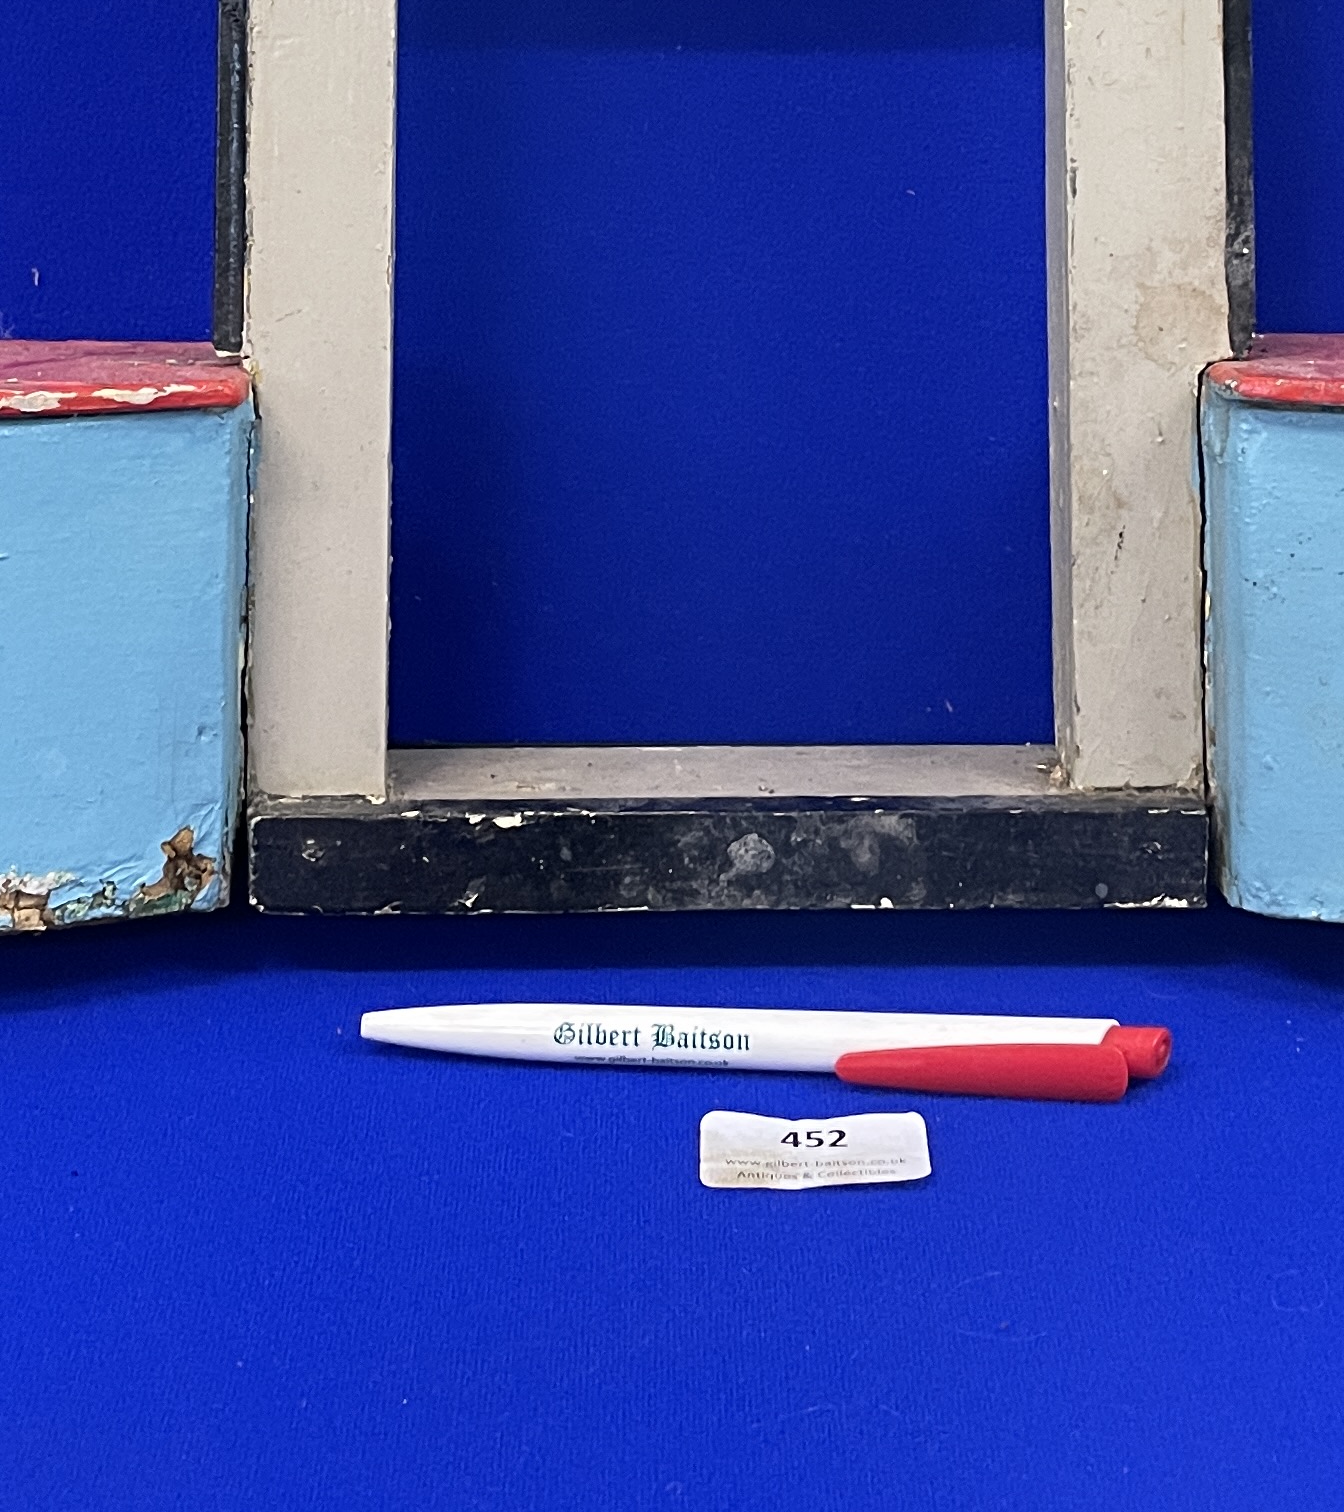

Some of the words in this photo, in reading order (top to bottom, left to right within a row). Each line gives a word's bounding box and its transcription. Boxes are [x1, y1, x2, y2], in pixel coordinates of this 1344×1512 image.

[553, 1022, 641, 1048] Gilbert
[651, 1023, 750, 1051] Baitson
[781, 1129, 848, 1148] 452
